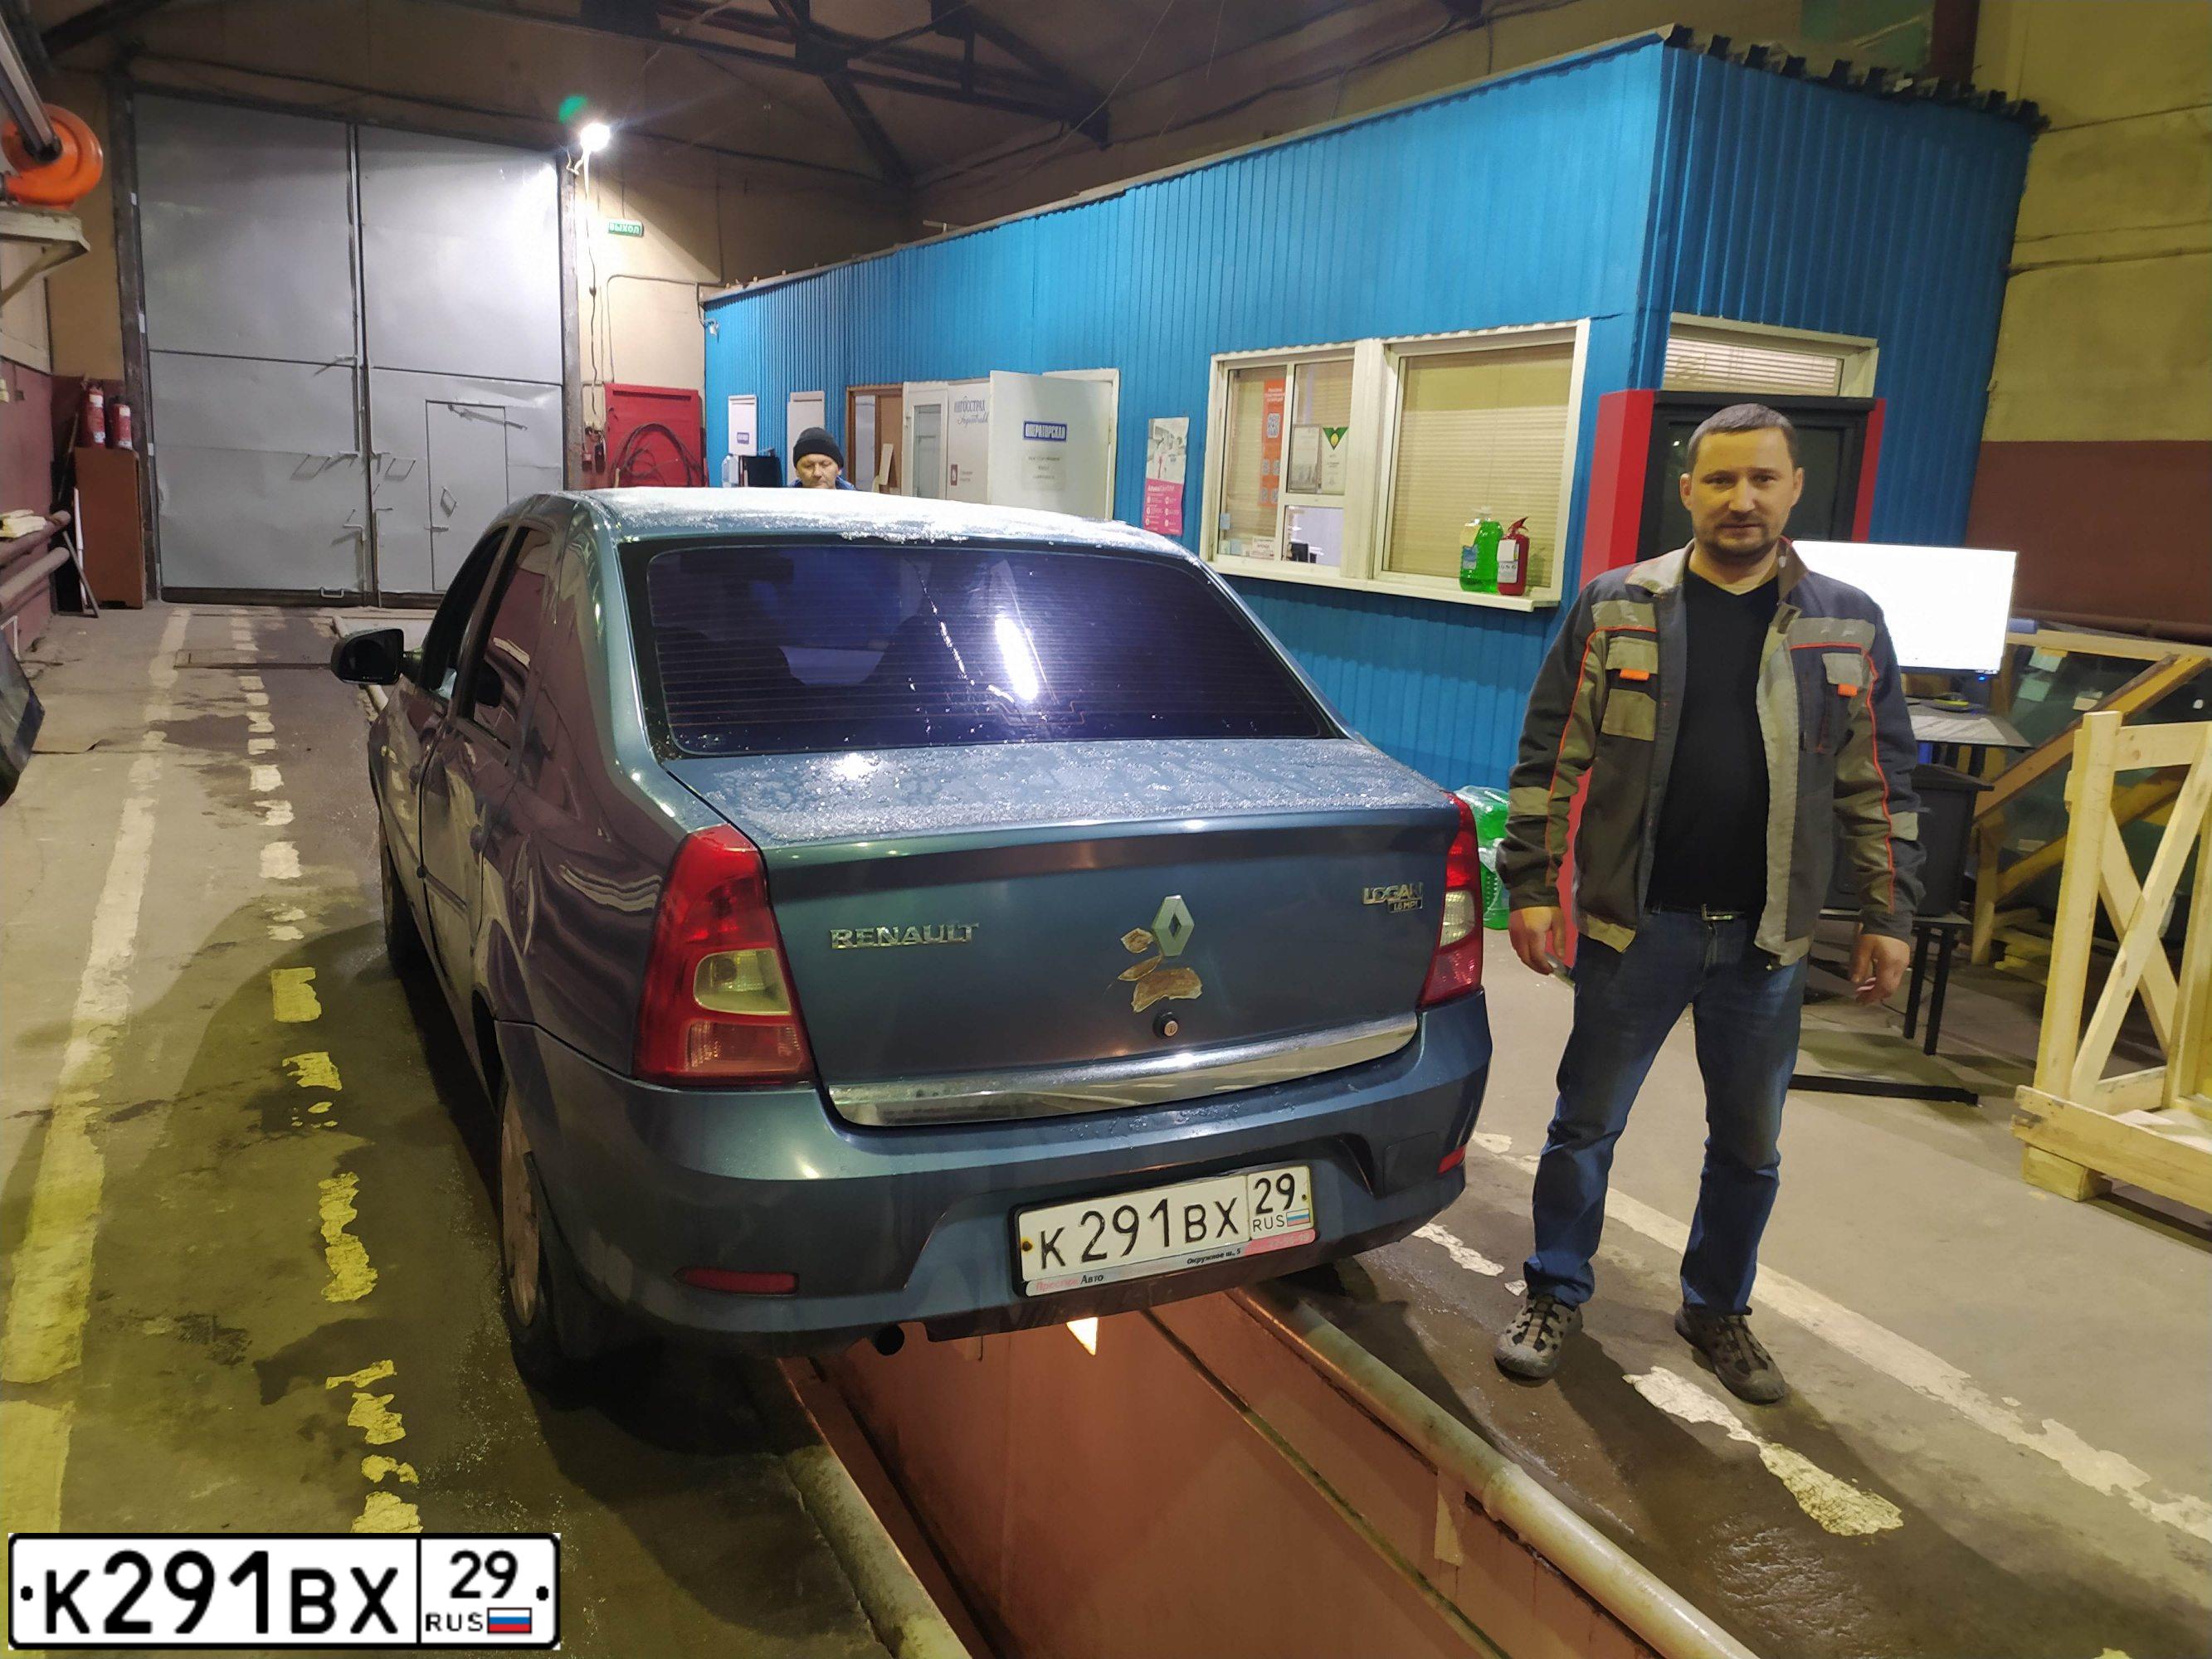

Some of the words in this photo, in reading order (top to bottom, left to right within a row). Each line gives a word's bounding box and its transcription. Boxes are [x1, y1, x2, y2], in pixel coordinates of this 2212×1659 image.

[609, 223, 641, 235] ВЫХОД
[954, 399, 986, 413] ГОССТРАХ
[1362, 882, 1423, 905] LOGAN
[830, 922, 980, 950] RENAULT
[1040, 1196, 1238, 1269] К291ВХ
[1253, 1173, 1296, 1216] 29
[1252, 1213, 1285, 1233] RUS
[1186, 1252, 1225, 1265] Окружное
[1080, 1274, 1104, 1285] Авто
